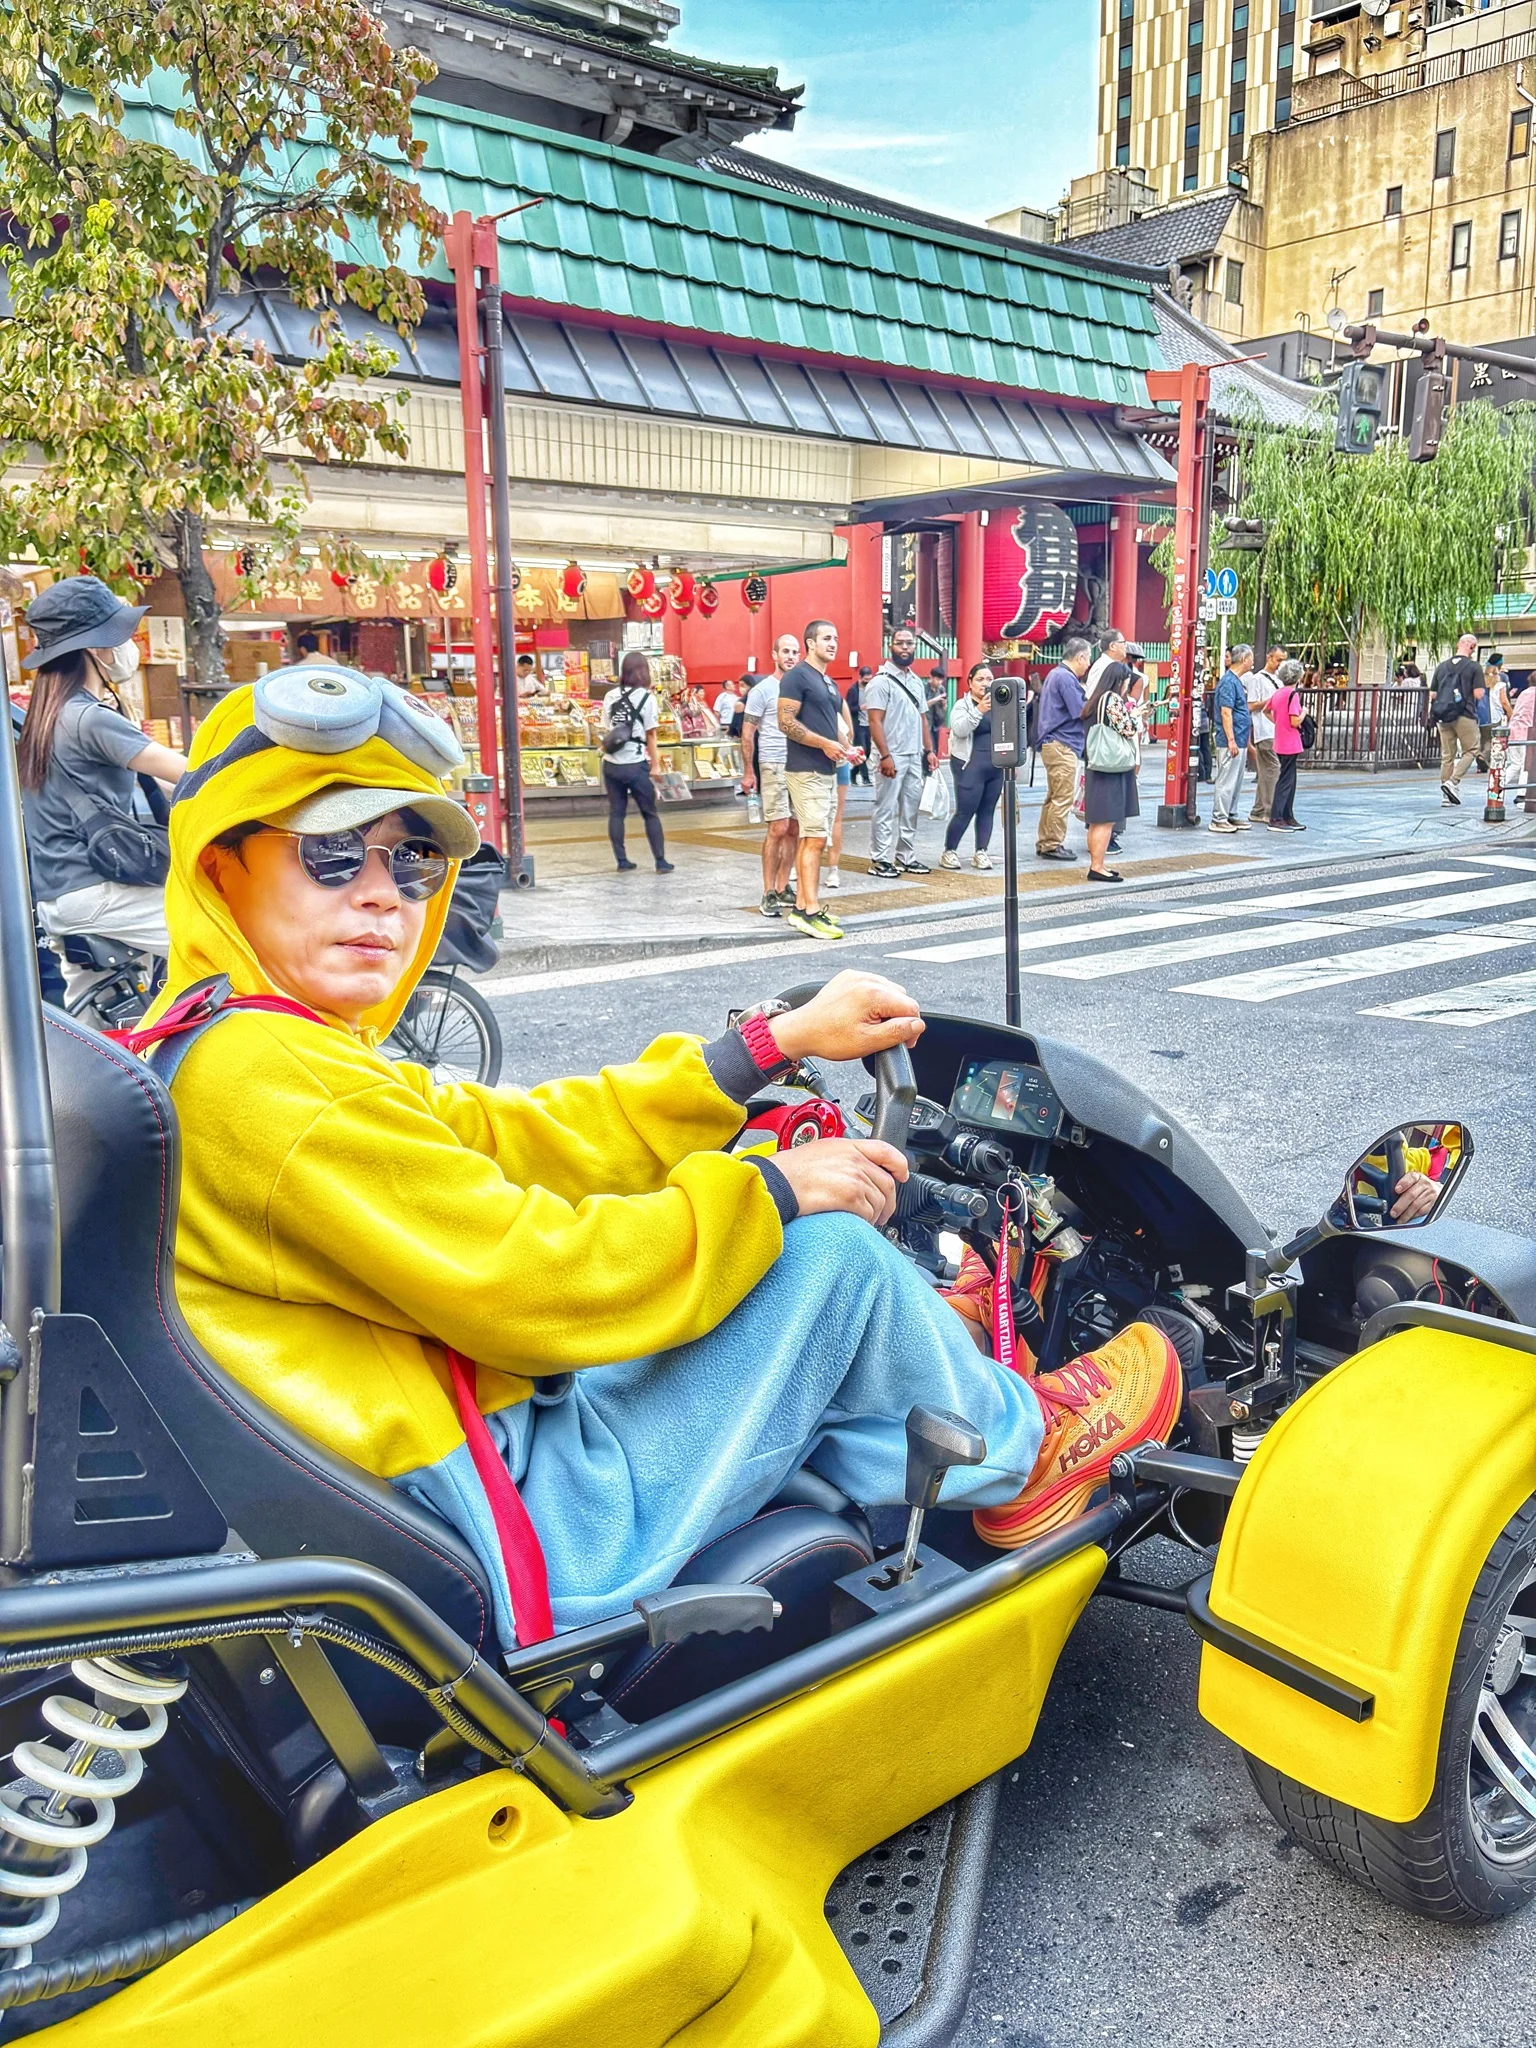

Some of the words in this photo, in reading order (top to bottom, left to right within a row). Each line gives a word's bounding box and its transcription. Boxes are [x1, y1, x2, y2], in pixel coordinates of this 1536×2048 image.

[998, 1284, 1007, 1300] BY
[998, 1303, 1013, 1366] KARTZILLA
[1058, 1411, 1126, 1474] HOKA
